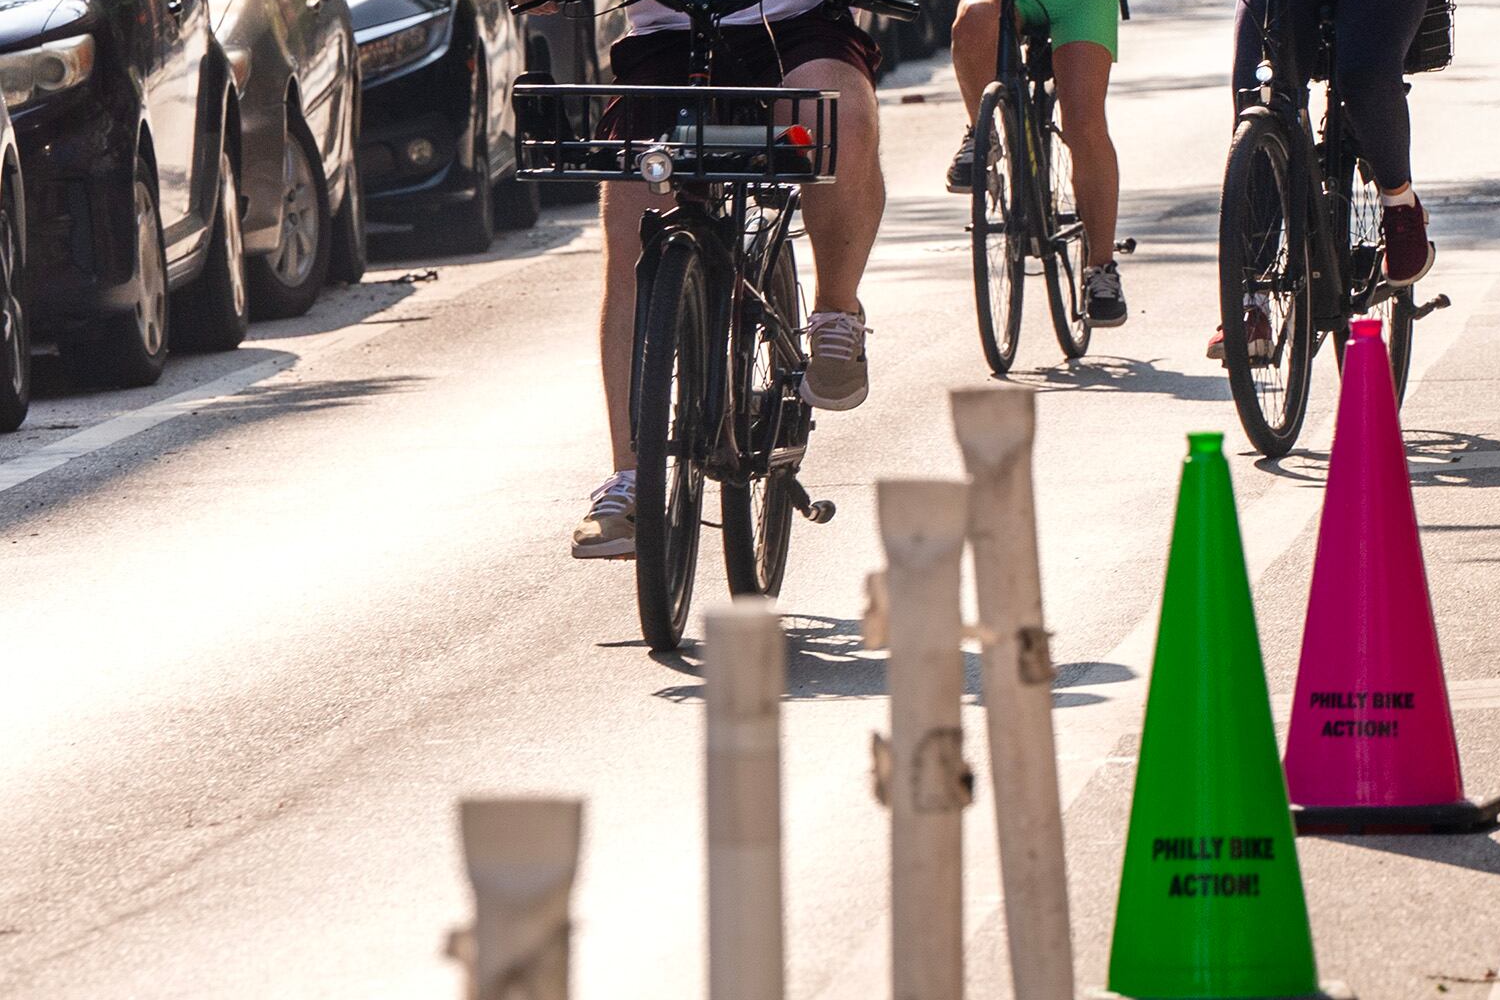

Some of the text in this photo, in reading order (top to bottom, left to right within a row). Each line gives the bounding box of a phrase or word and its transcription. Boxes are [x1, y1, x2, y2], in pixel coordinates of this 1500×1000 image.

[1310, 692, 1415, 709] PHILLY BIKE
[1321, 720, 1398, 737] ACTION!
[1153, 837, 1275, 860] PHILLY BIKE
[1168, 873, 1260, 897] ACTION!
